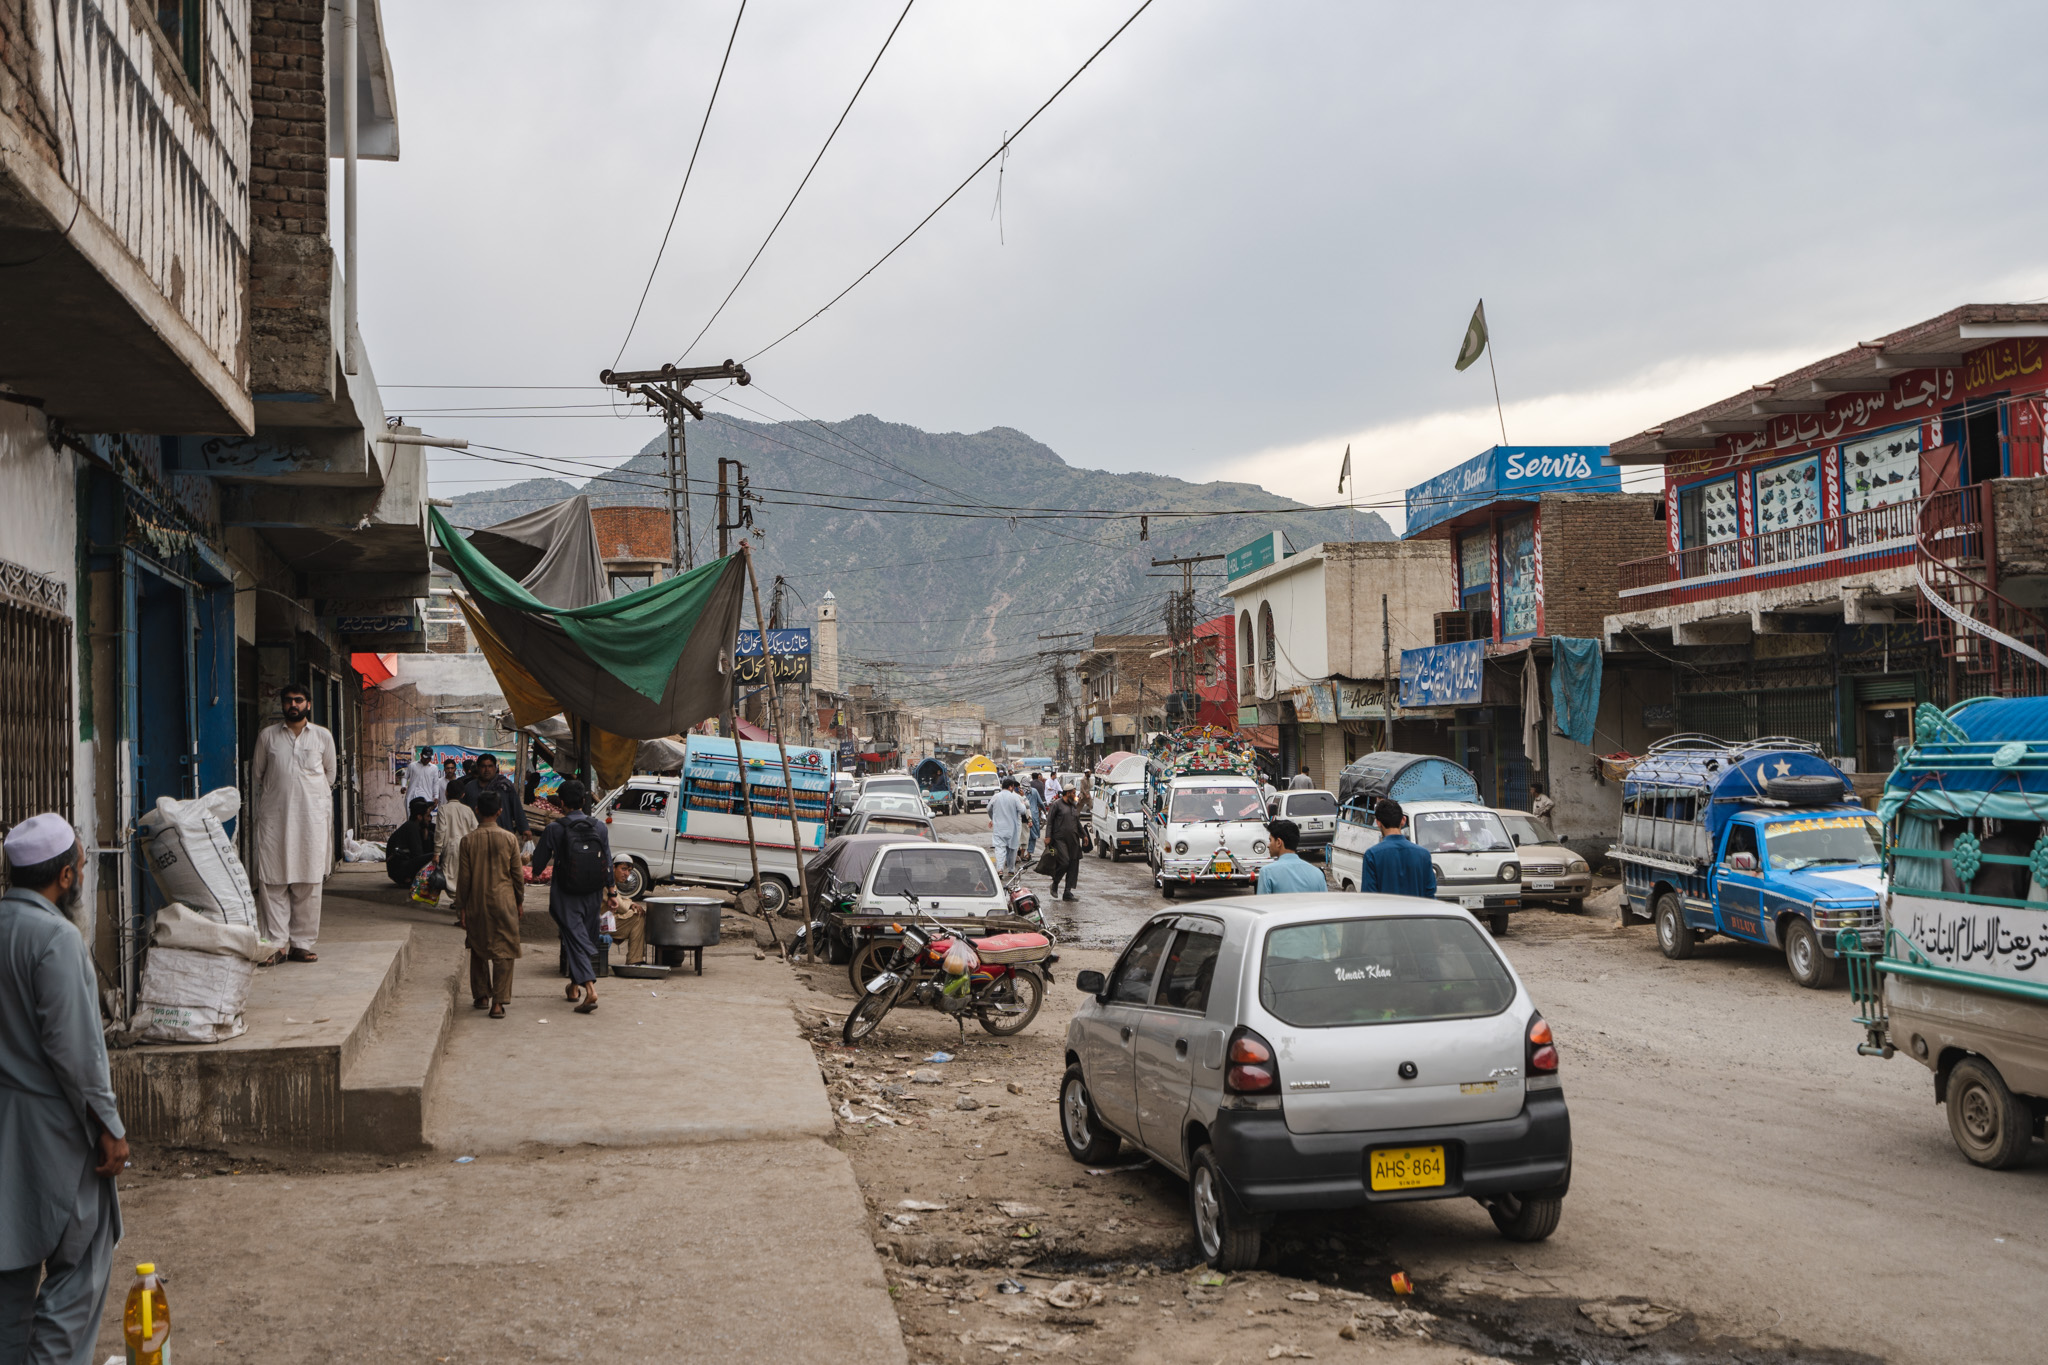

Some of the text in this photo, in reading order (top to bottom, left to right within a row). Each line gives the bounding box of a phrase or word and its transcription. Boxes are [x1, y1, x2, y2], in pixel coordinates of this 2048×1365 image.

[1505, 452, 1592, 480] Servis
[1462, 464, 1487, 492] Bata
[1824, 446, 1840, 550] Servis
[1742, 470, 1755, 567] Bata
[1228, 557, 1239, 574] HBL
[1534, 528, 1545, 608] Bata
[689, 767, 715, 779] YOUR
[759, 775, 784, 787] VERY
[804, 780, 825, 790] NICE
[1789, 816, 1865, 834] ALLAH
[1334, 964, 1392, 982] Umair Khan
[1489, 1067, 1518, 1078] ALTO
[1290, 1080, 1330, 1091] SUZUKI
[1375, 1158, 1441, 1179] AHS-864
